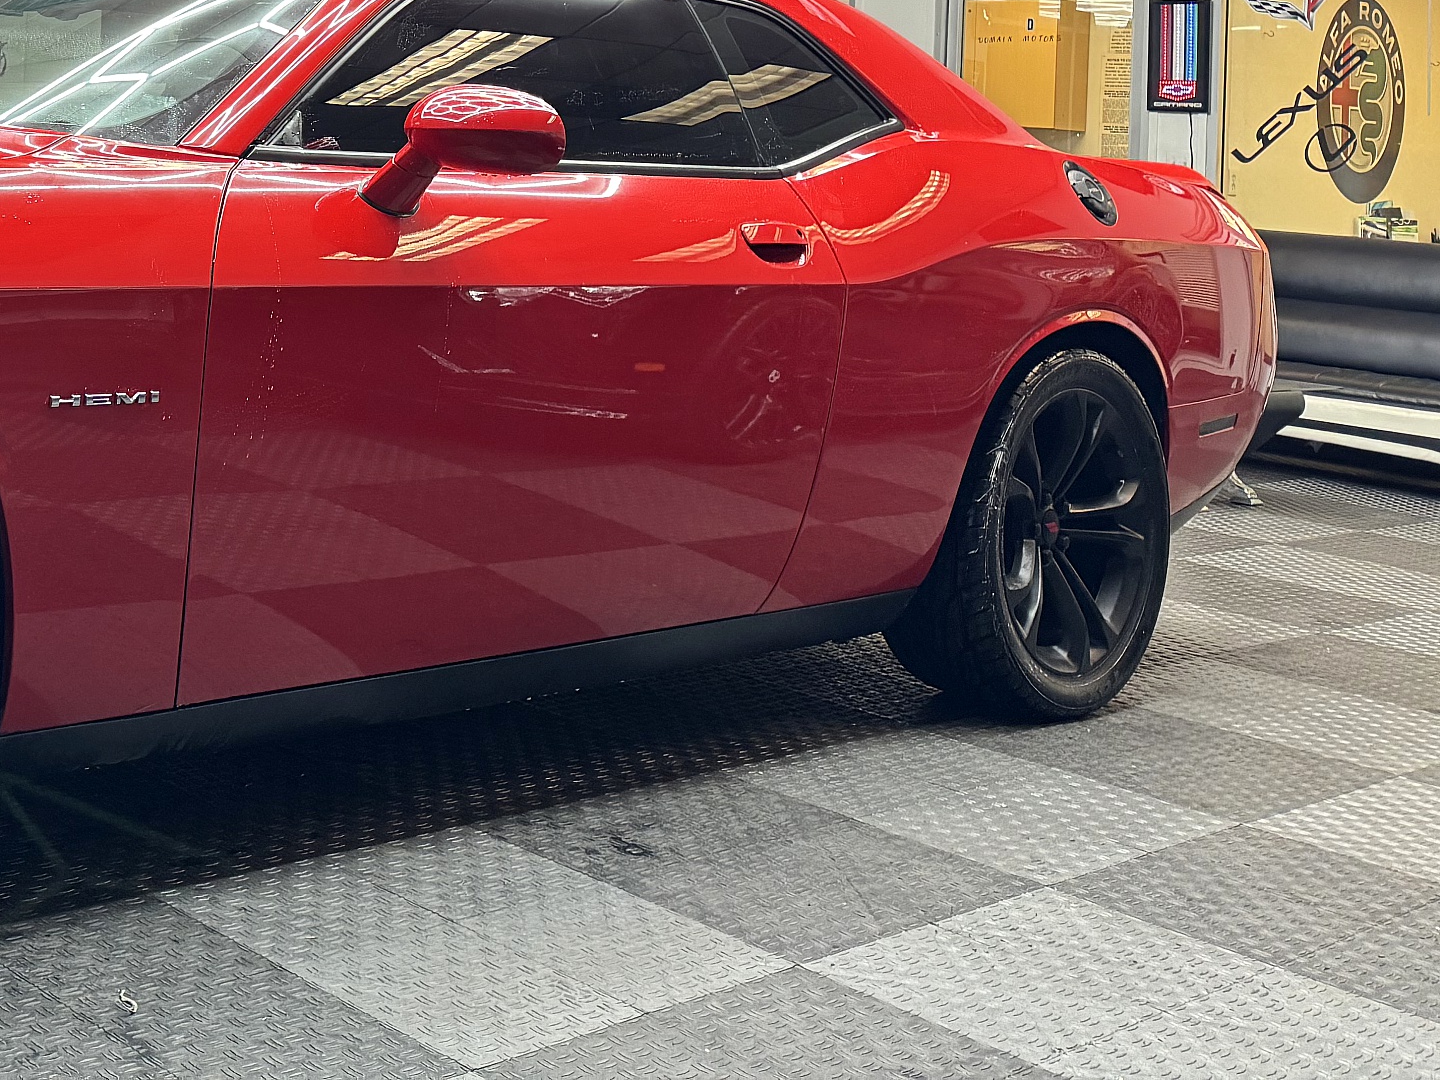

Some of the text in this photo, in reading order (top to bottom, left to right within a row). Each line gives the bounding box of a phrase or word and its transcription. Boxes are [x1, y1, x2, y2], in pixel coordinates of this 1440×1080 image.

[1231, 43, 1369, 164] LEXUS
[1319, 1, 1404, 105] ALFA ROMEO
[49, 390, 160, 408] HEMI
